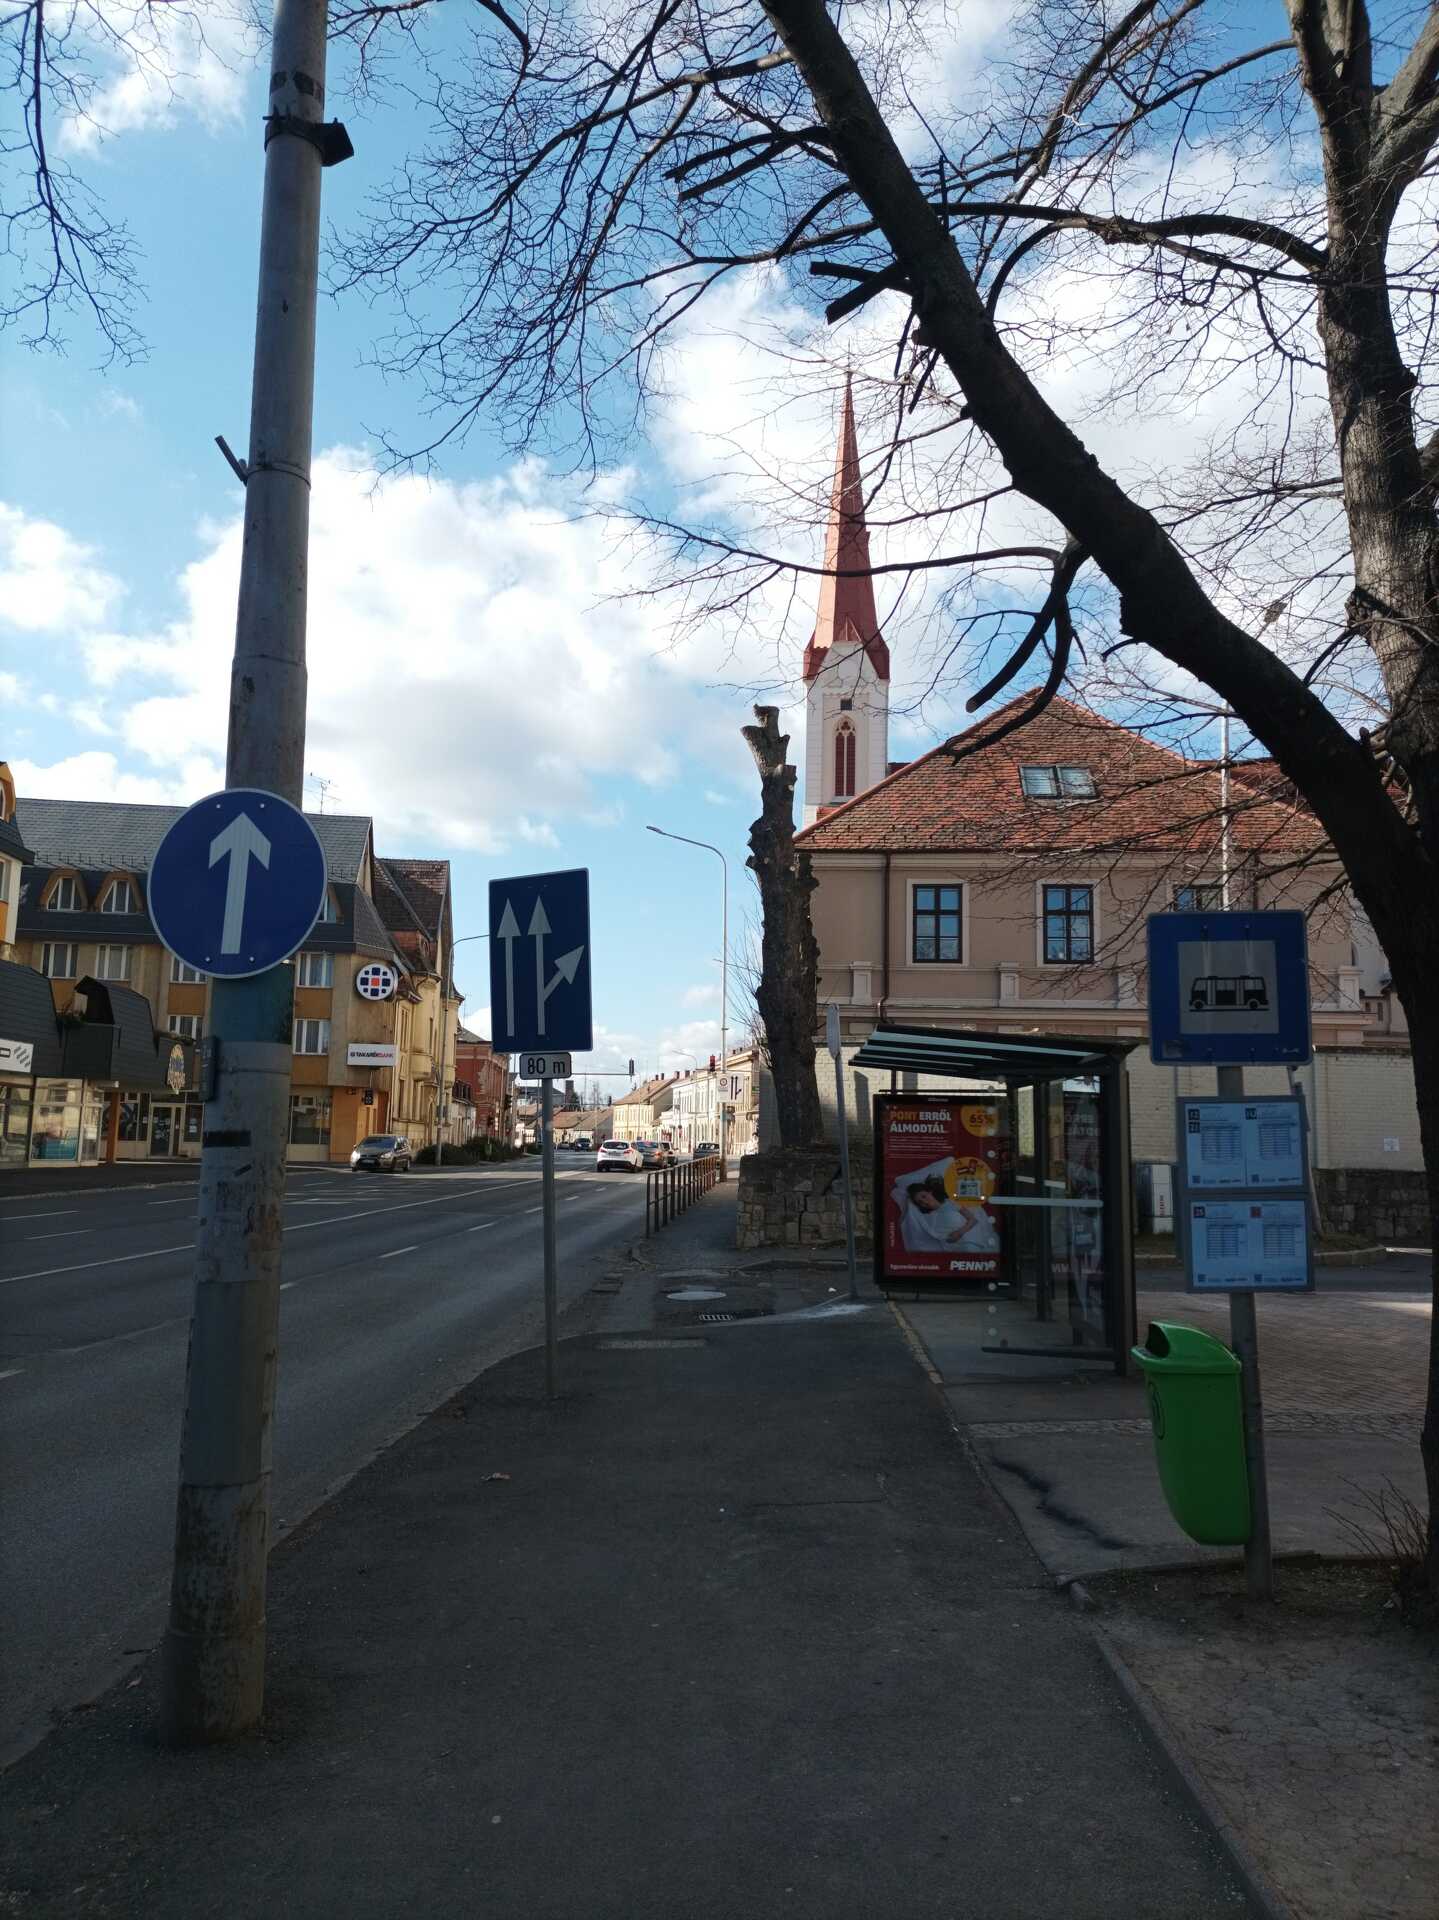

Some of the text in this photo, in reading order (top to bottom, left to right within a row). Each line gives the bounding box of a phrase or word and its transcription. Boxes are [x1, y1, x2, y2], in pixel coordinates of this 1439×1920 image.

[527, 1057, 566, 1075] 80 m
[890, 1109, 951, 1121] PONT ERRŐL
[950, 1260, 992, 1271] PENNY
